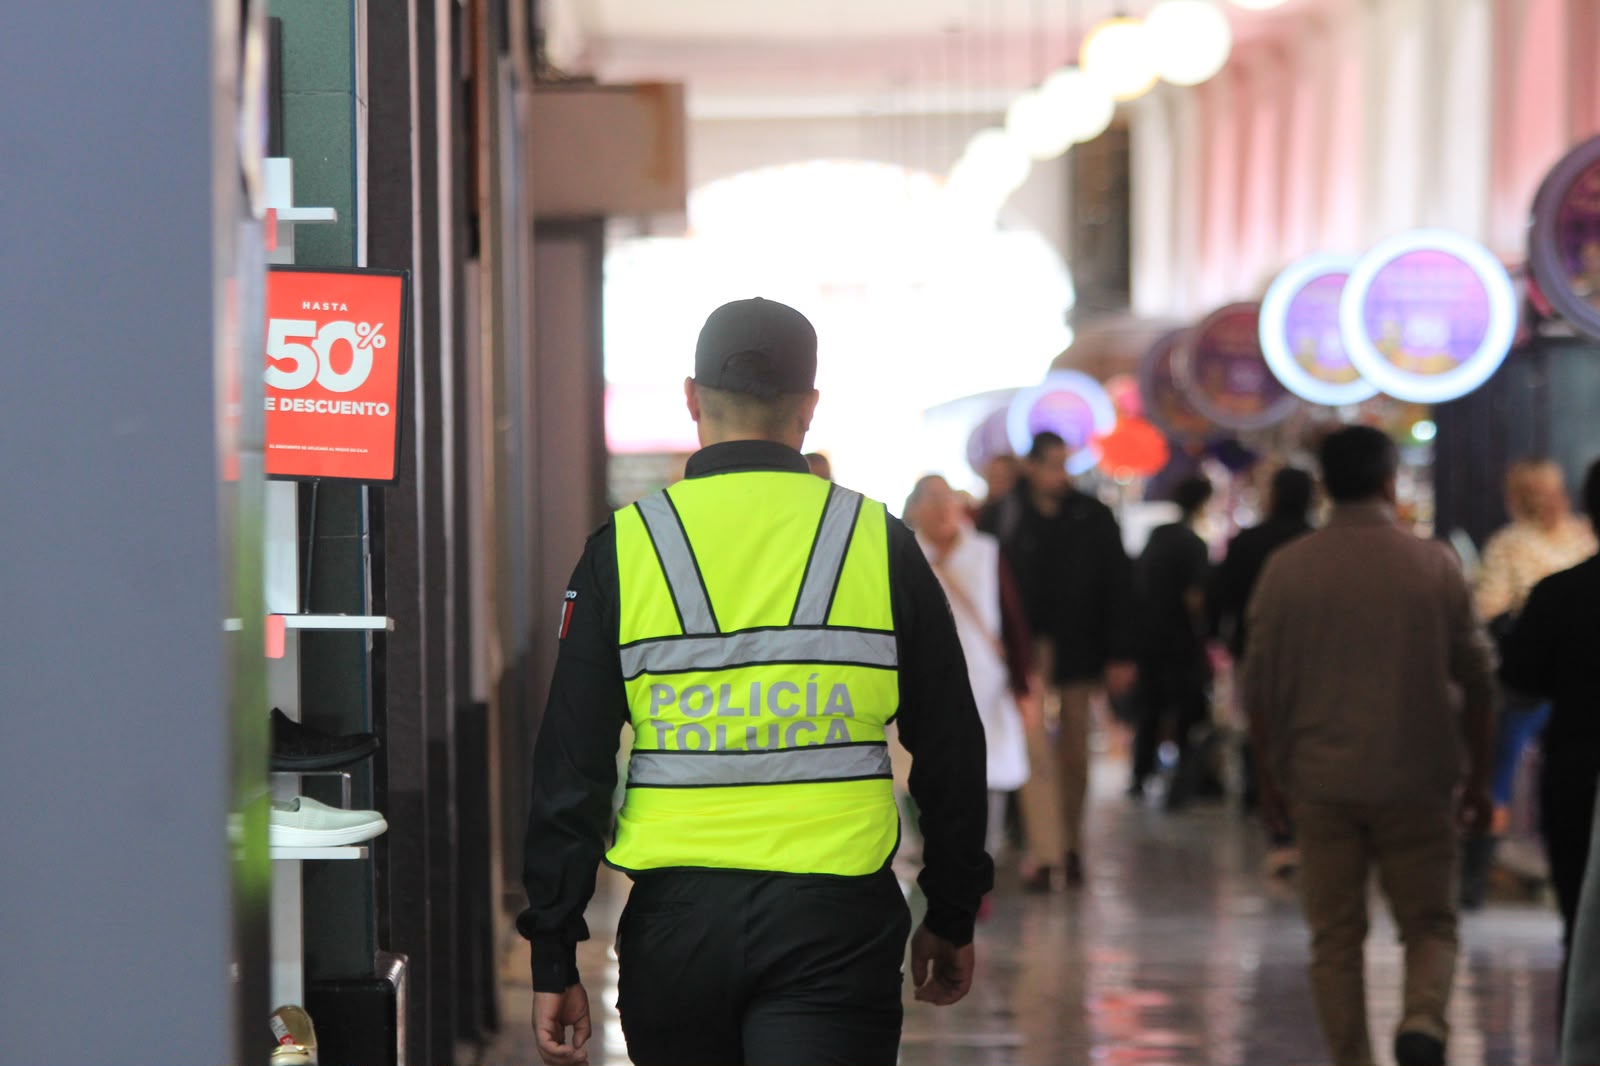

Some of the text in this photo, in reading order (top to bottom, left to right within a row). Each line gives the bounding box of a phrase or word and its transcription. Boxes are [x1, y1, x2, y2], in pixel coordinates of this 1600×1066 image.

[302, 301, 348, 312] HASTA
[264, 318, 386, 393] 50%
[280, 398, 390, 417] DESCUENTO
[650, 673, 855, 718] POLICÍA
[650, 718, 852, 751] TOLUCA
